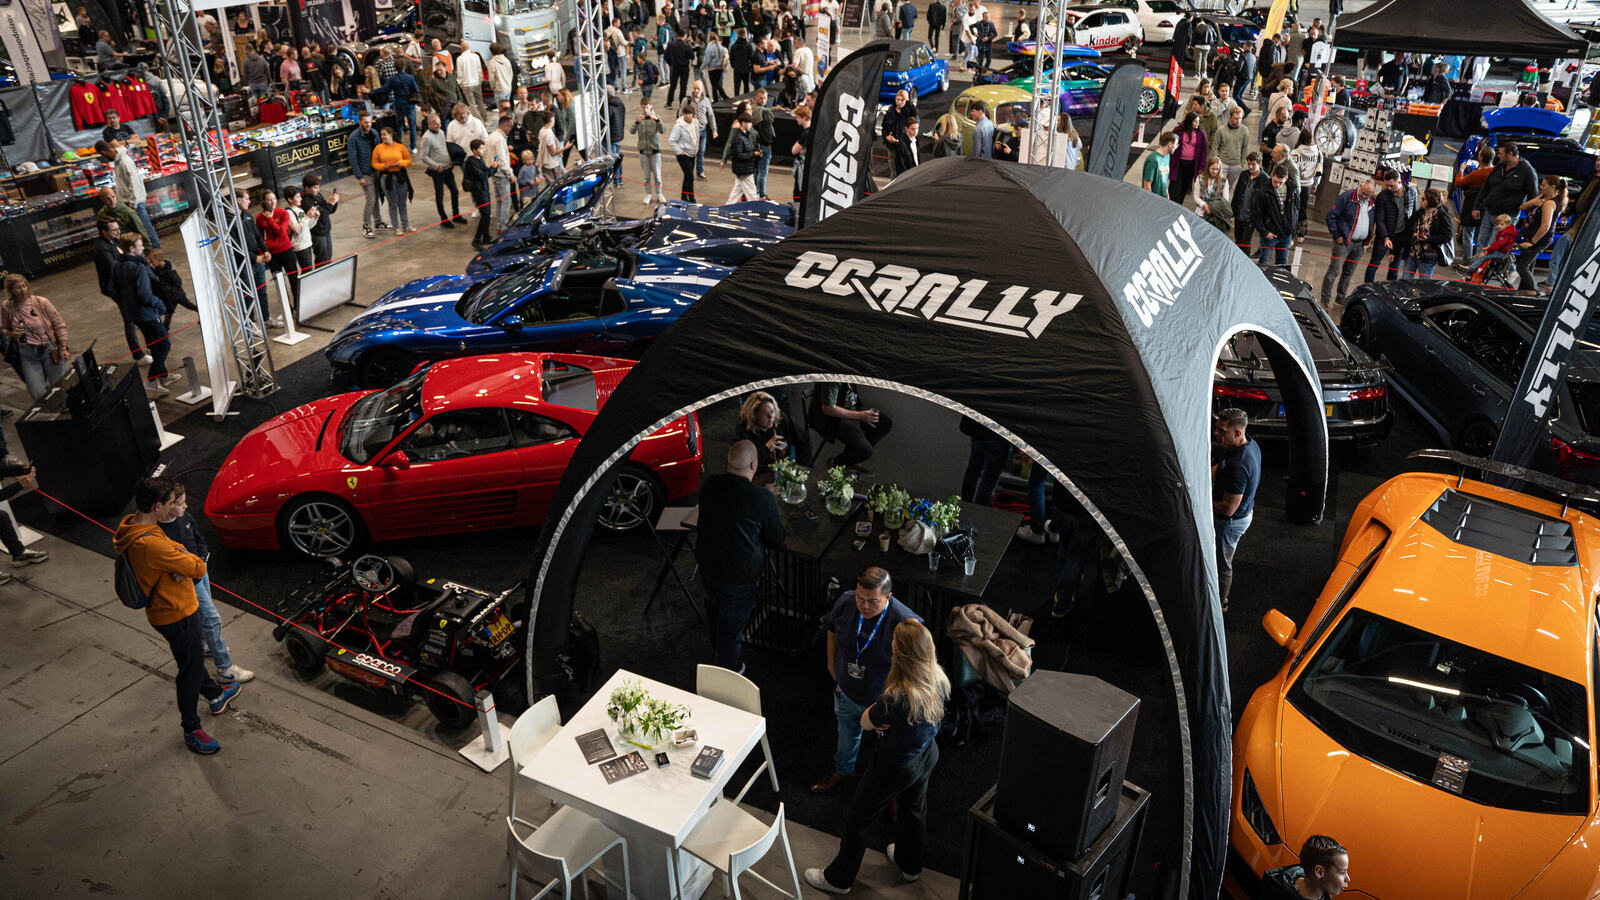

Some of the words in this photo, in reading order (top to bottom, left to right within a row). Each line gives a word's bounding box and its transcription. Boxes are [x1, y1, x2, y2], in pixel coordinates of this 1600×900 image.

[1089, 34, 1121, 46] kinder
[275, 144, 321, 166] DELATOUR
[327, 134, 348, 149] DELA
[818, 92, 865, 221] CCRA
[784, 251, 1084, 340] CCRALLY
[1123, 214, 1205, 328] CCRALLY
[1524, 232, 1600, 419] RALLY
